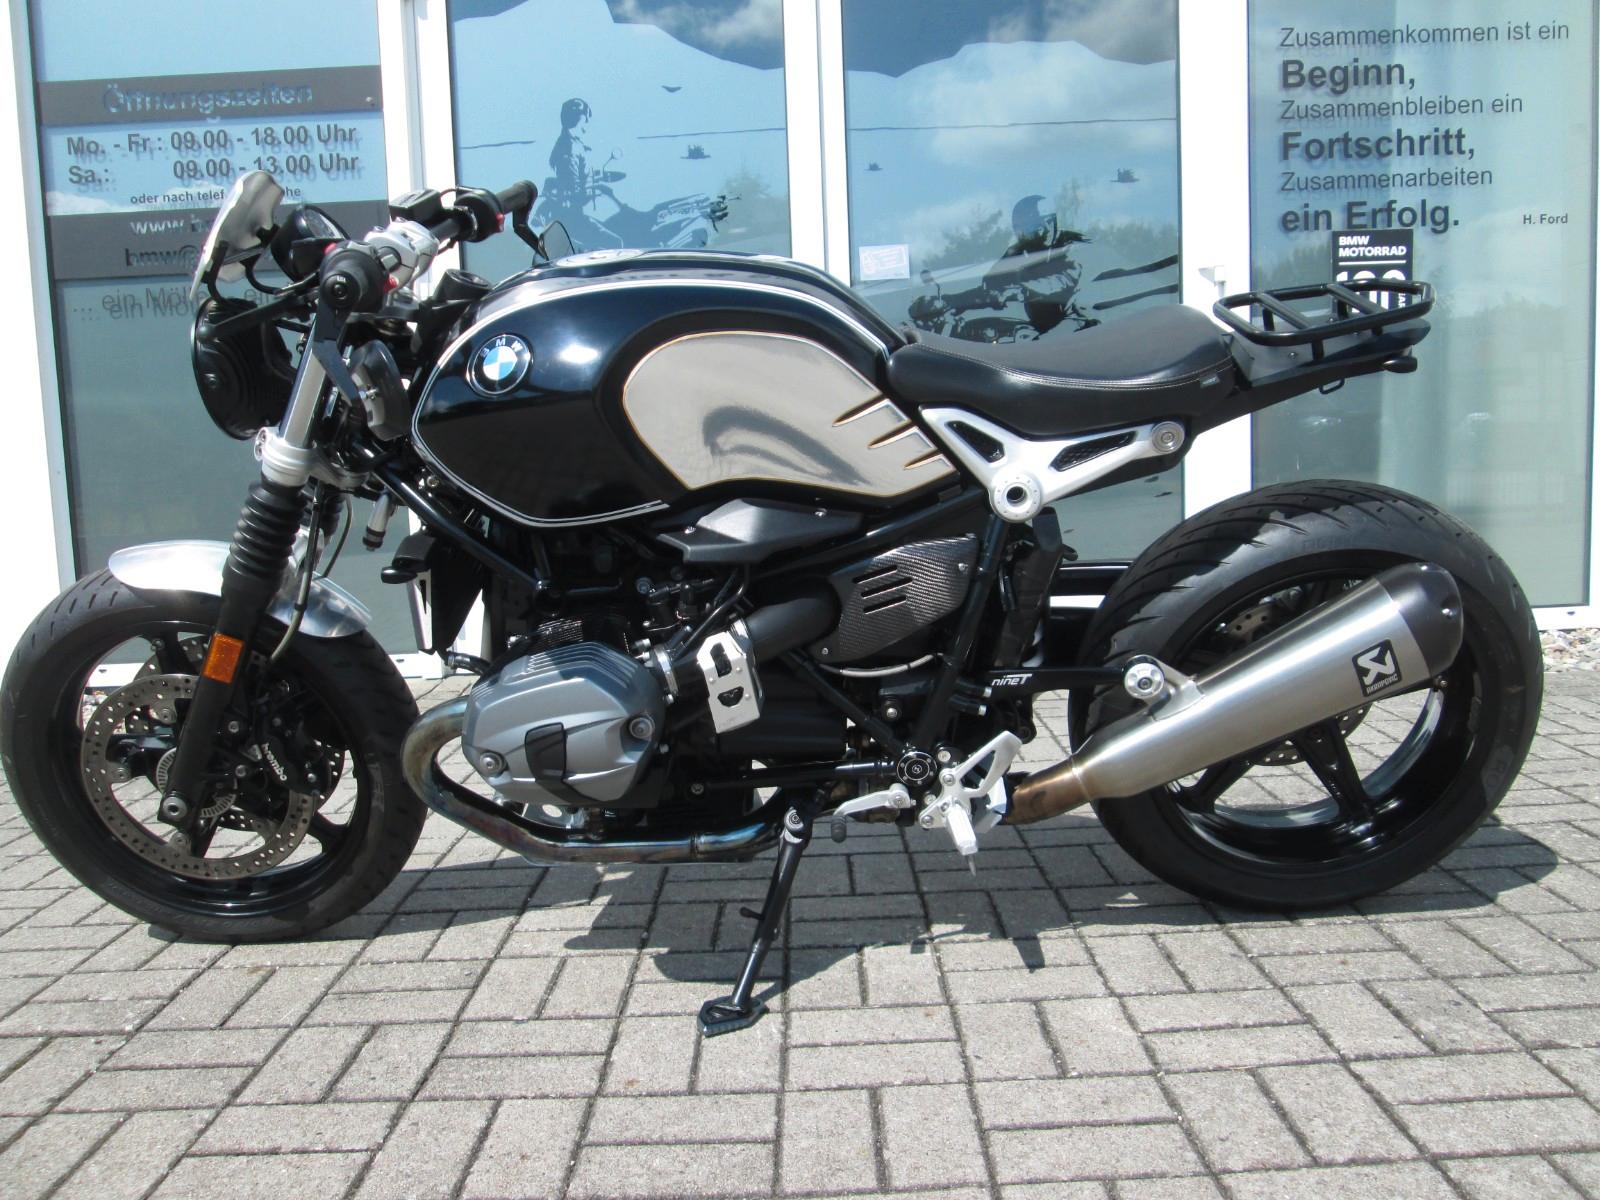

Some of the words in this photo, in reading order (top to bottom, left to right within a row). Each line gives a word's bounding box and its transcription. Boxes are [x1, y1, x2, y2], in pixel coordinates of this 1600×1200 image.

[1280, 24, 1499, 47] Zusammenkommen
[1507, 21, 1532, 40] ist
[1538, 20, 1570, 40] ein
[1282, 58, 1415, 94] Beginn,
[1280, 96, 1483, 119] Zusammenbleiben
[1491, 93, 1523, 113] ein
[67, 136, 105, 156] Mo.
[170, 129, 228, 150] 09.00
[251, 125, 308, 146] 18.00
[316, 123, 357, 144] Uhr
[1282, 127, 1475, 160] Fortschritt,
[173, 158, 231, 179] 09.00
[253, 154, 311, 175] 13.00
[319, 152, 359, 173] Uhr
[1280, 167, 1493, 191] Zusammenarbeiten
[130, 193, 160, 204] oder
[163, 191, 193, 202] nach
[1281, 202, 1333, 232] ein
[1346, 199, 1460, 234] Erfolg.
[1523, 214, 1536, 225] H.
[1540, 213, 1569, 225] Ford
[1338, 235, 1370, 246] BMW
[1338, 245, 1407, 257] MOTORRAD
[102, 288, 136, 311] ein
[479, 337, 523, 358] BMW
[991, 673, 1033, 686] nineT
[261, 742, 288, 781] brembo
